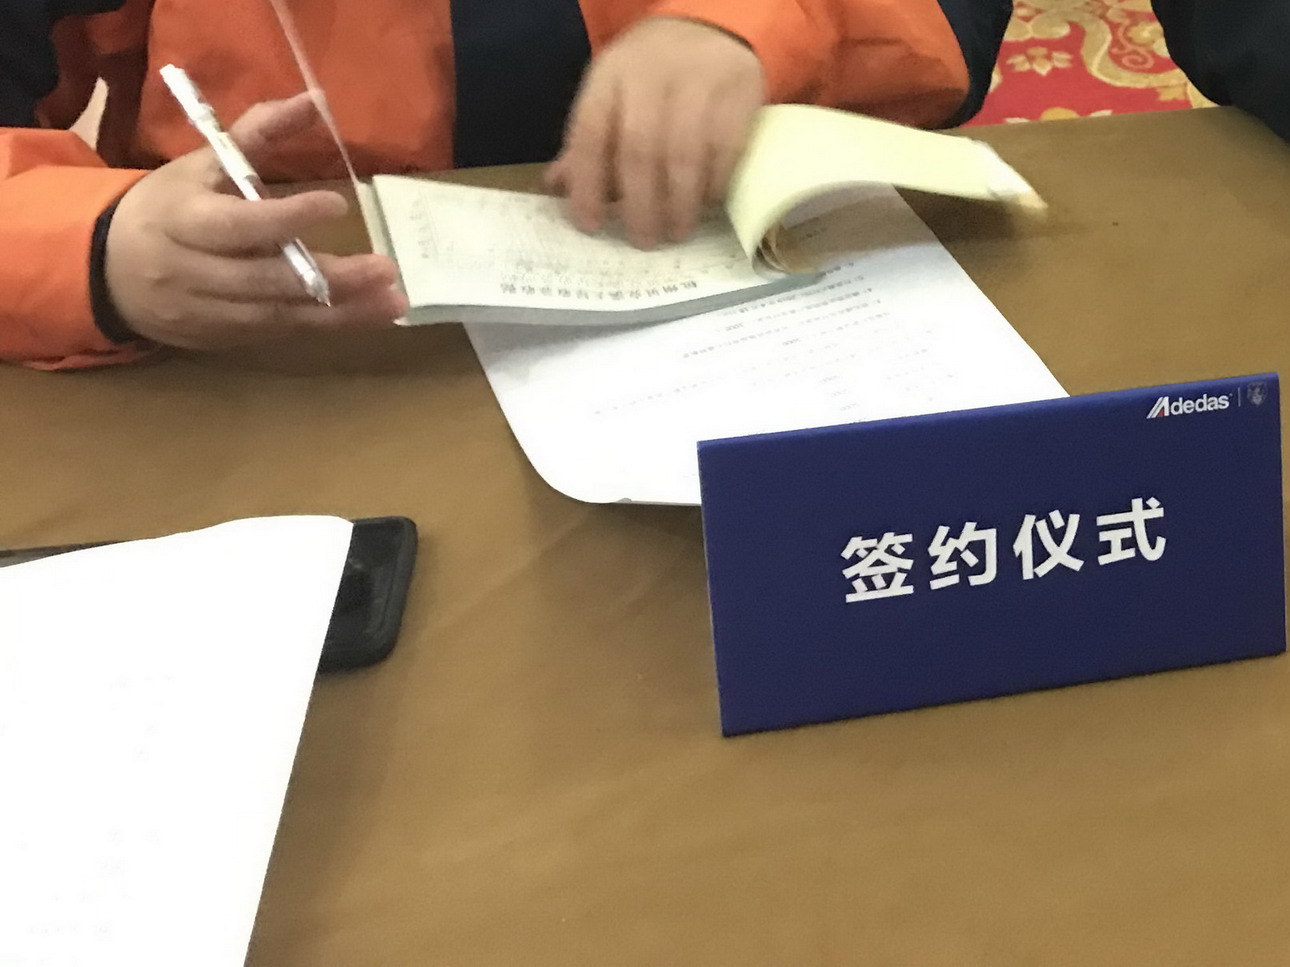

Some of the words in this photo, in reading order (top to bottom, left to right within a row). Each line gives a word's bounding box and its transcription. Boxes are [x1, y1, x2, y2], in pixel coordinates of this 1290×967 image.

[1146, 393, 1230, 419] Adedas
[840, 497, 1167, 603] 签约仪式
